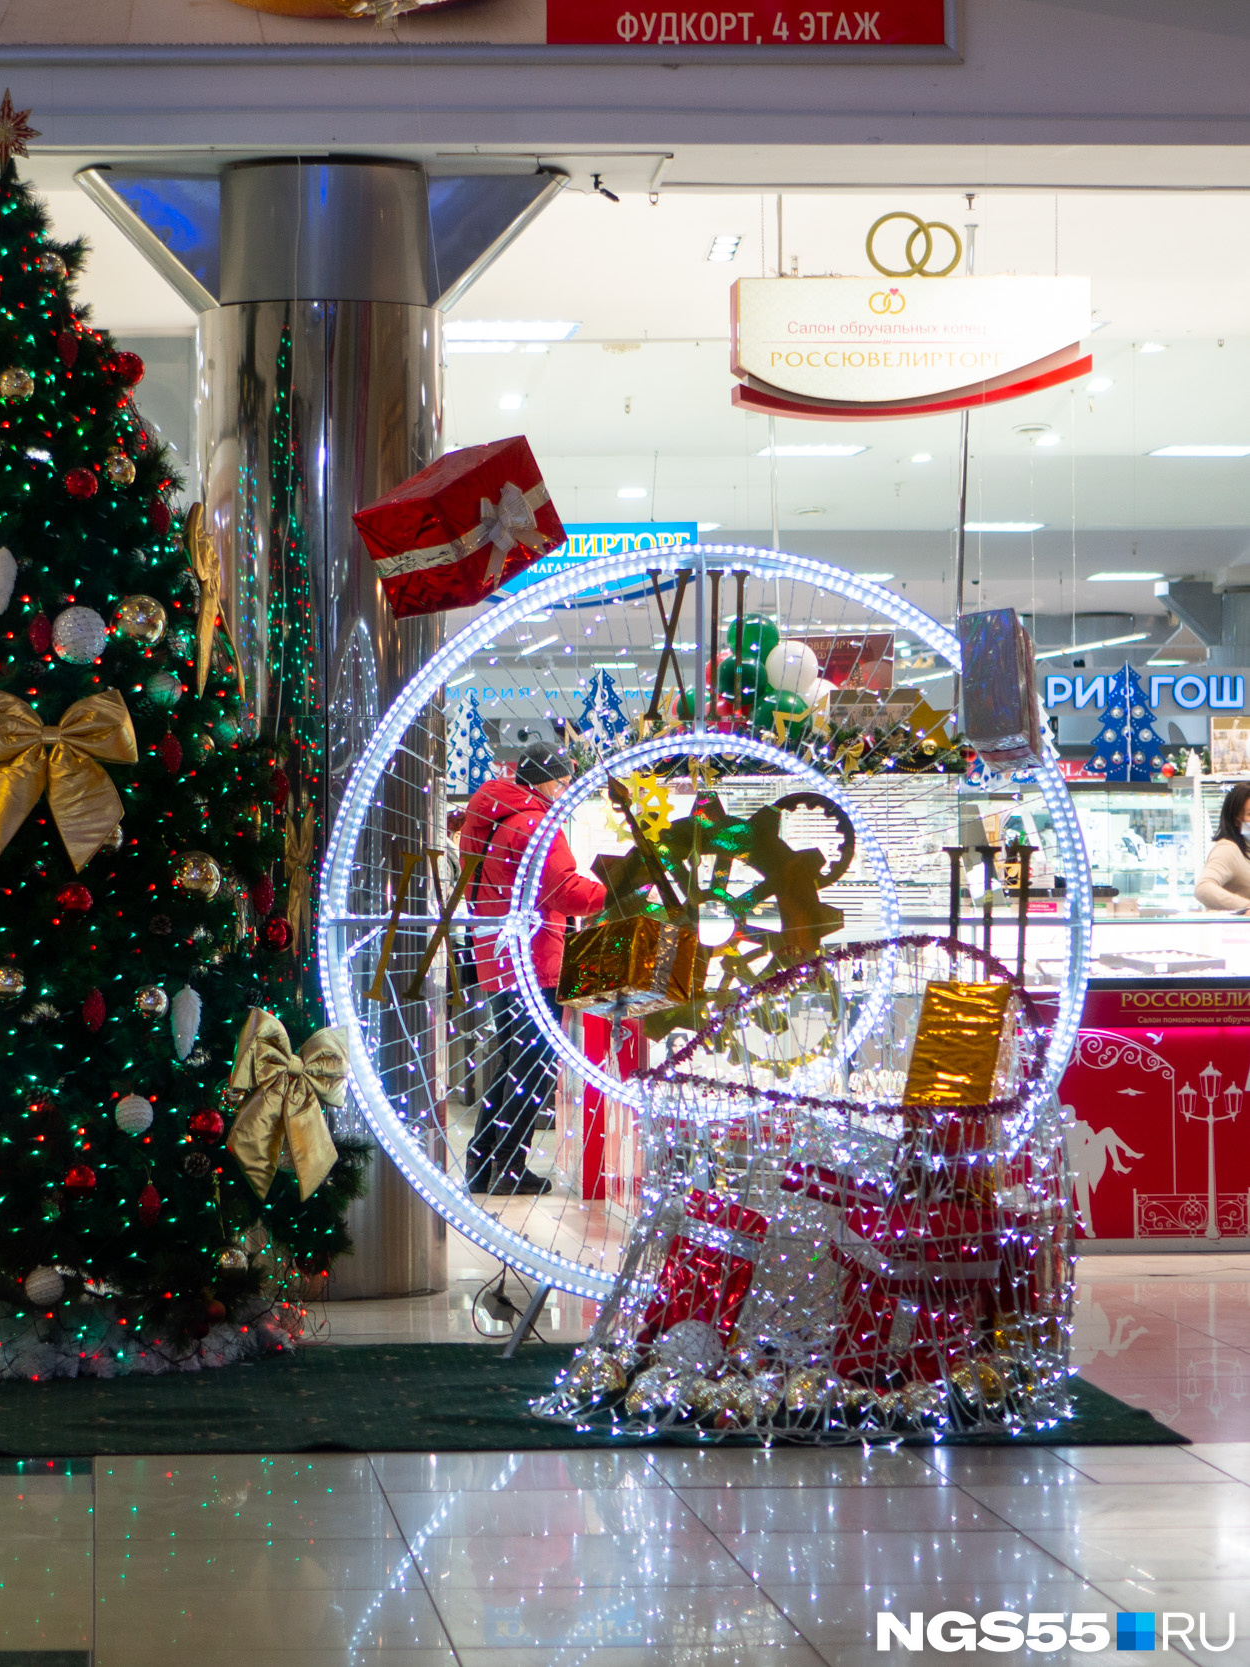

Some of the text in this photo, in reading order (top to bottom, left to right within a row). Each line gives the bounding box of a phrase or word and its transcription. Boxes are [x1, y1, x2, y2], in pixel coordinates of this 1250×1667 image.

[616, 11, 881, 45] ФУДКОРТ, 4 ЭТАЖ
[787, 320, 836, 336] Салон
[839, 320, 938, 337] обручальных
[770, 351, 1003, 368] РОССЮВЕЛИРТОРГ
[1150, 674, 1244, 709] ГОШ
[1137, 1016, 1161, 1024] Салон
